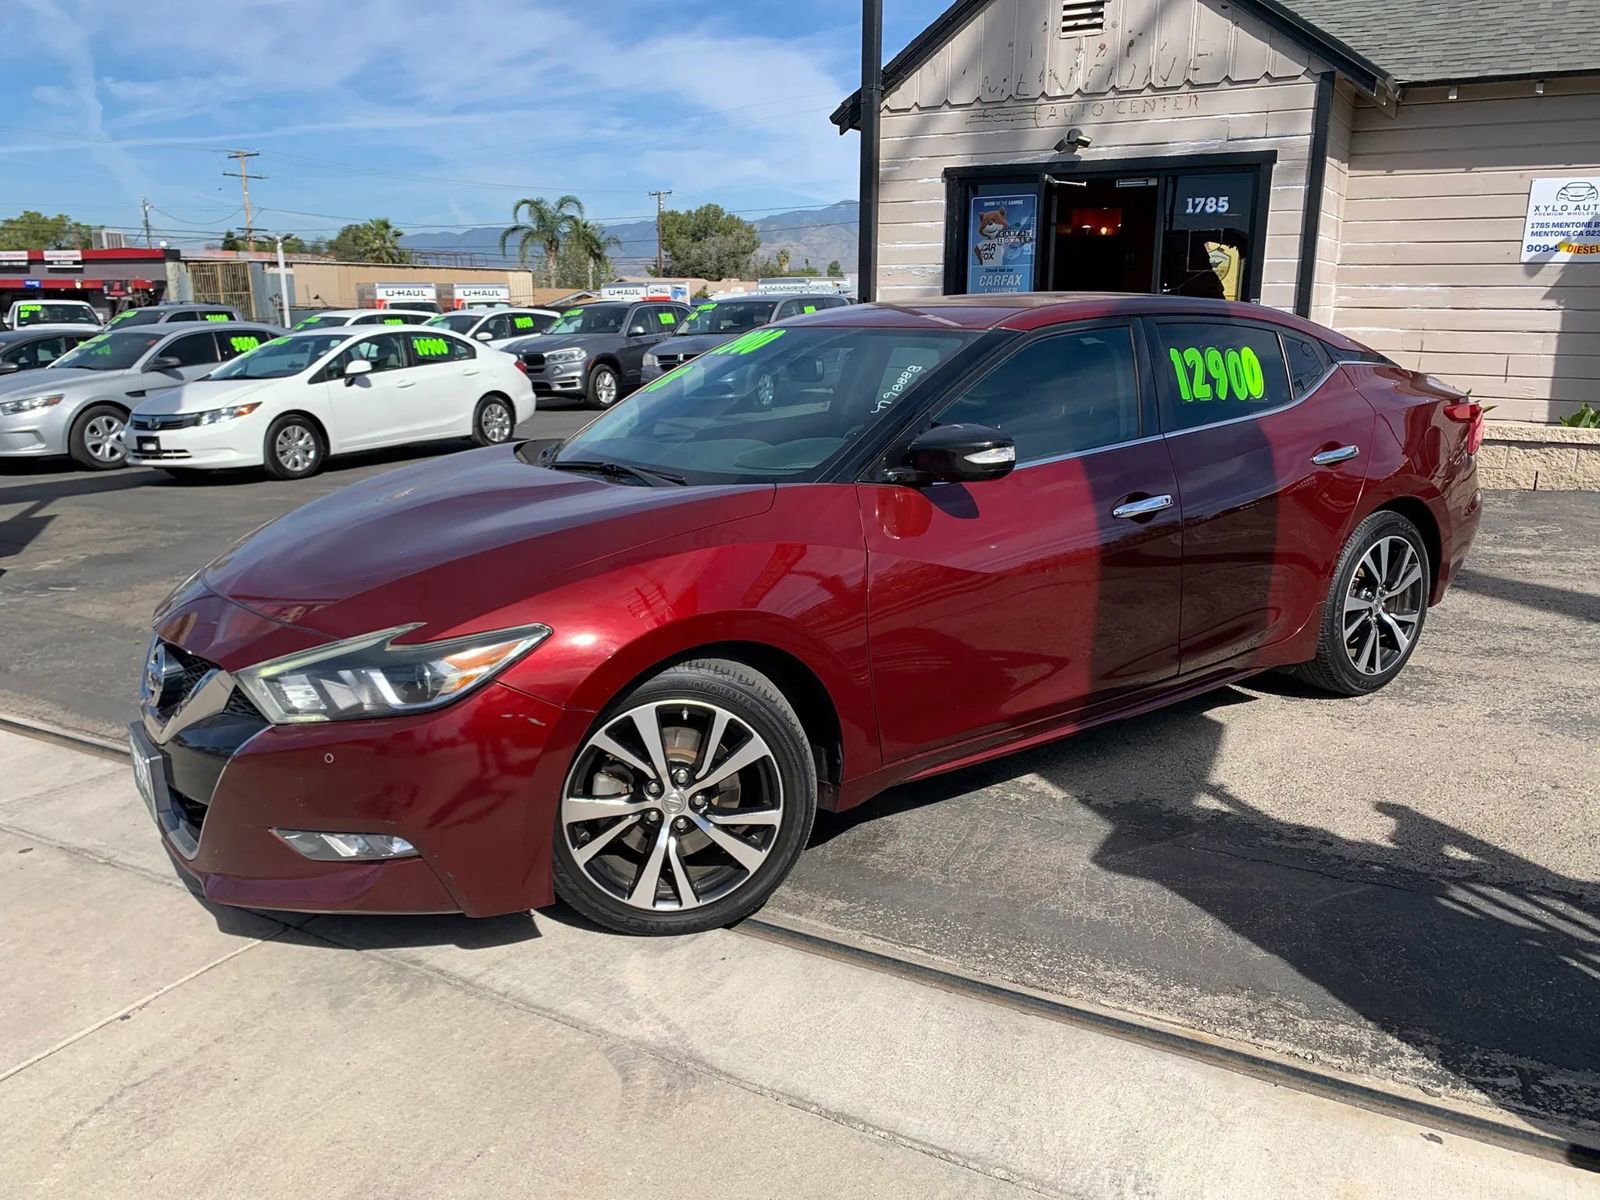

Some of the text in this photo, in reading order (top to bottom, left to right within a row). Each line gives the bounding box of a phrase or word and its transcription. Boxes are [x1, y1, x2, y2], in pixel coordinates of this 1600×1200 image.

[1115, 95, 1200, 114] CENTER
[1186, 196, 1230, 214] 1785
[1534, 204, 1568, 212] XYLO
[1551, 221, 1593, 229] MENTONE
[983, 243, 996, 252] CAR
[1567, 245, 1600, 254] DIESEL
[979, 274, 1023, 287] CARFAX
[414, 338, 449, 356] 10900
[1169, 346, 1265, 402] 12900
[687, 681, 752, 709] YOKOHAMA
